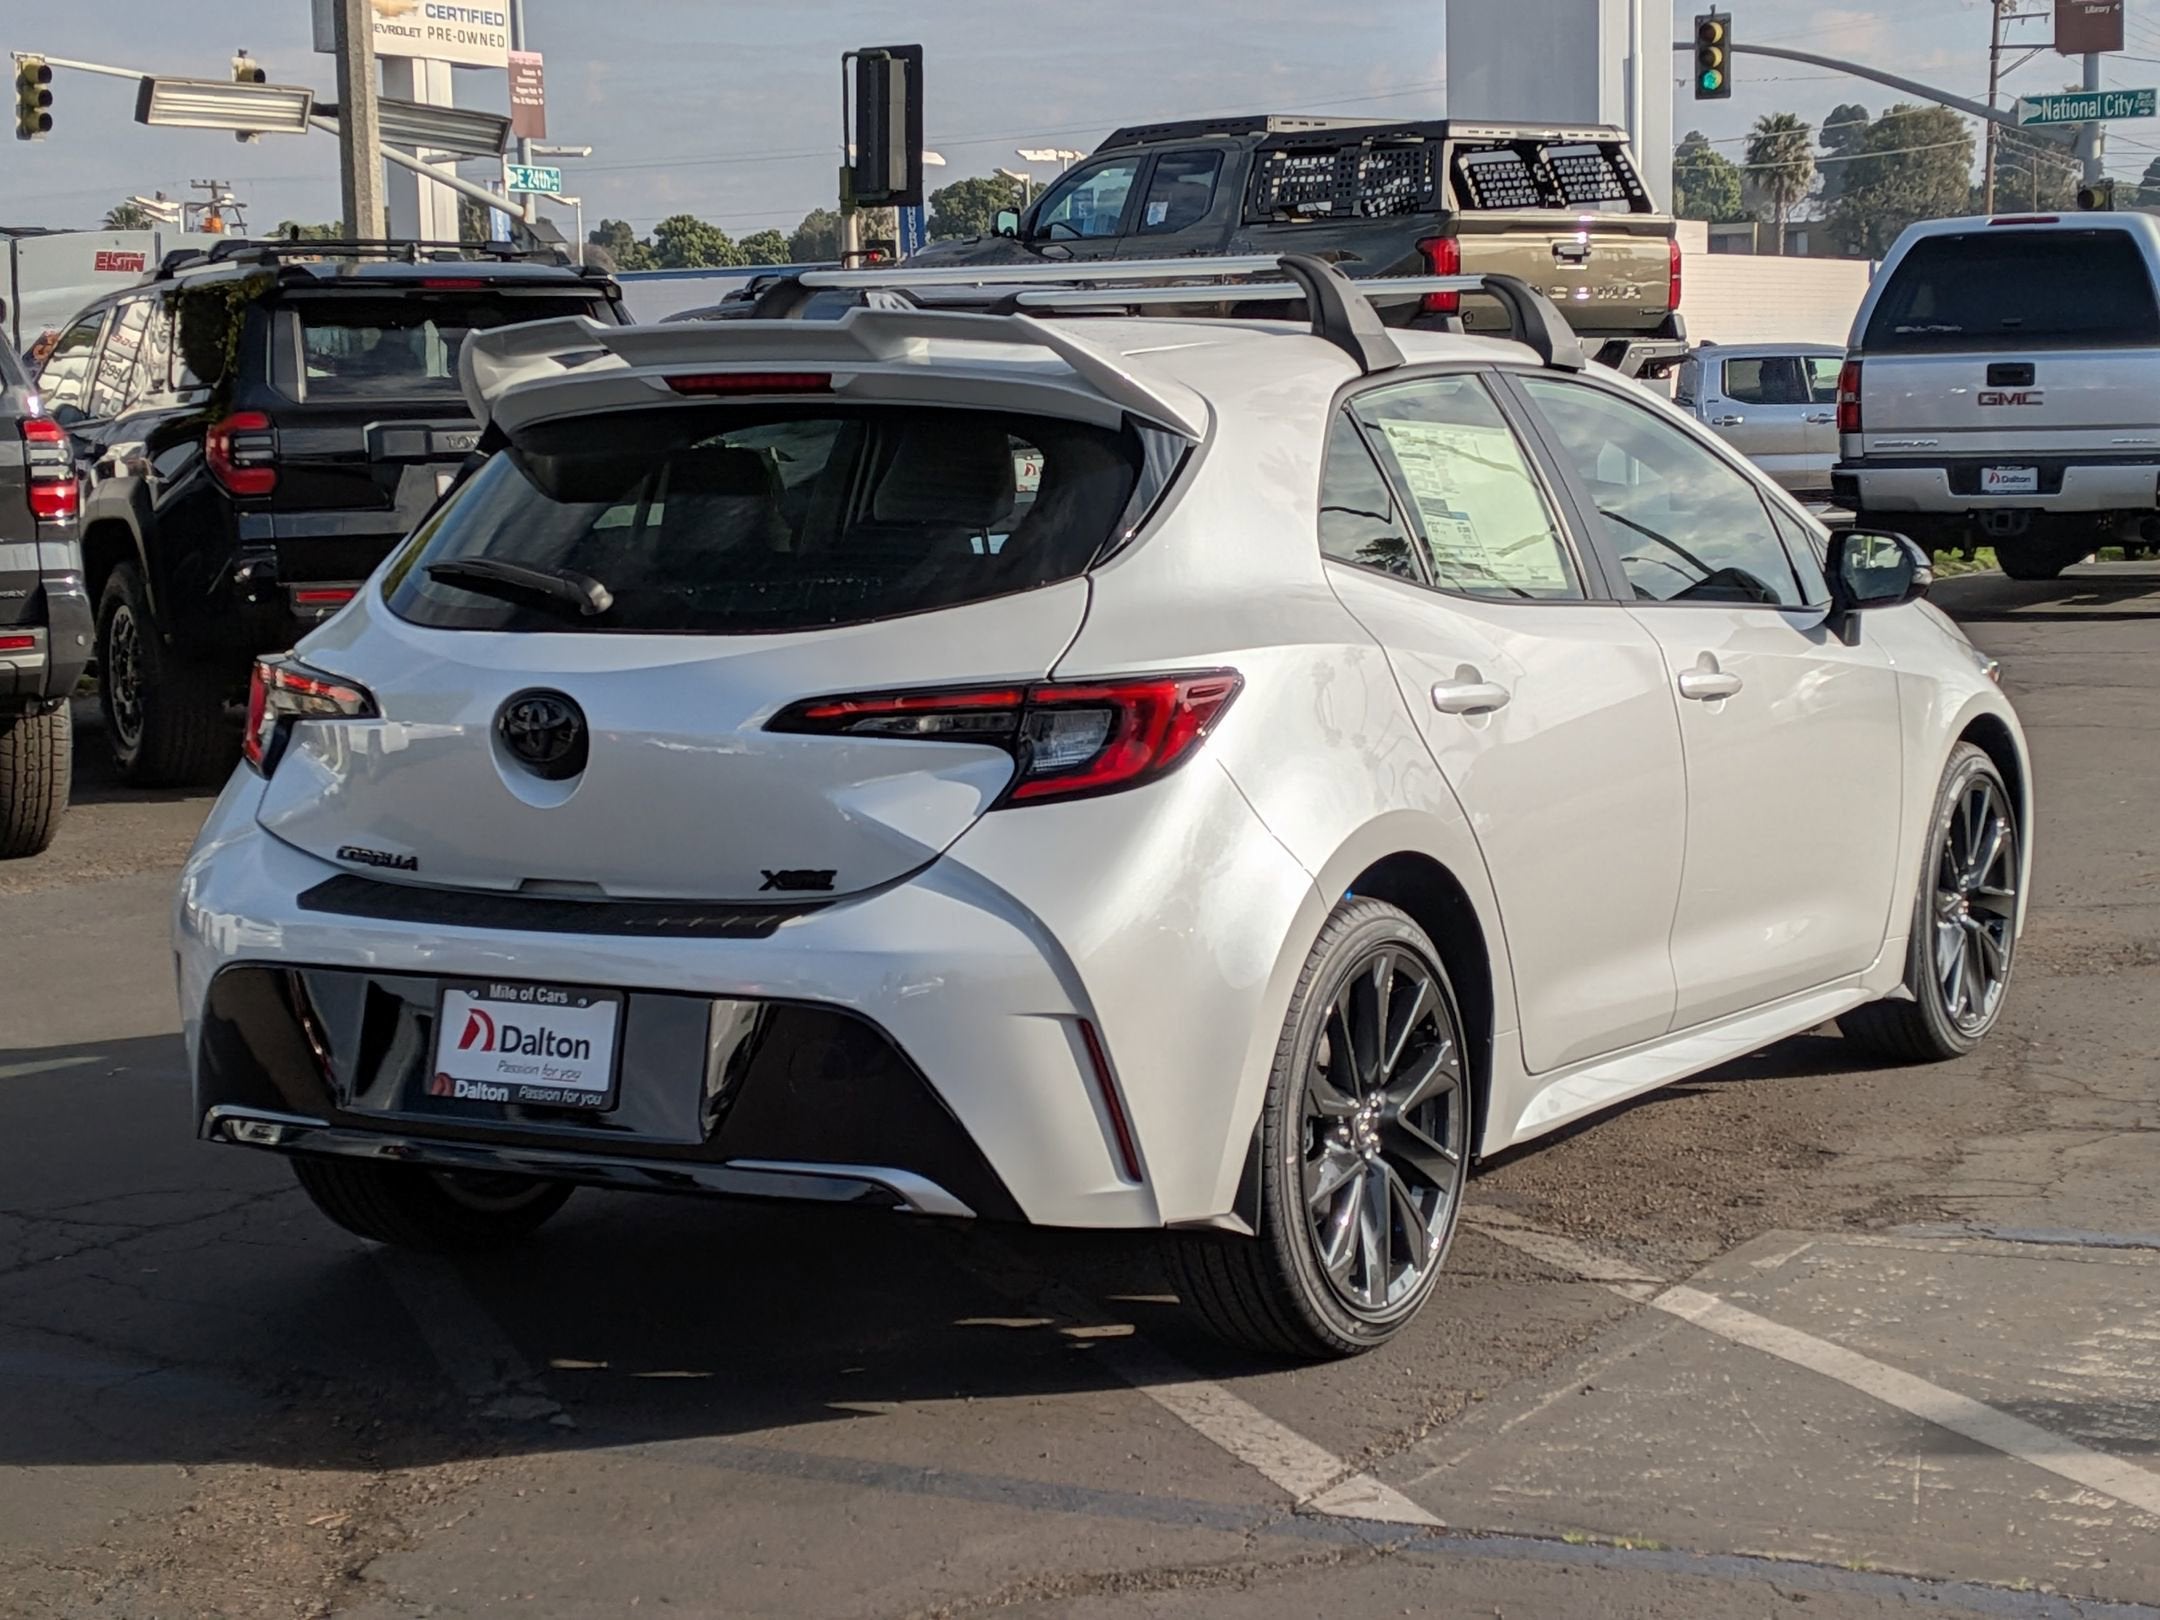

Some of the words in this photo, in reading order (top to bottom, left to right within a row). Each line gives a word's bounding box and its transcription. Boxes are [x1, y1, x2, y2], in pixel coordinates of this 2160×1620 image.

[425, 4, 505, 27] CERTIFIED
[373, 23, 422, 38] EVROLET
[427, 25, 505, 48] PRE-OWNED
[2042, 95, 2101, 121] National
[2104, 93, 2135, 117] City
[516, 168, 527, 189] E
[527, 169, 551, 190] 24th
[94, 251, 145, 273] ELGIN
[1978, 391, 2044, 406] GMC
[489, 984, 517, 1001] Mile
[519, 986, 535, 1001] of
[536, 988, 568, 1004] Cars
[499, 1025, 591, 1061] Dalton
[496, 1060, 540, 1076] Passion
[542, 1063, 558, 1078] for
[559, 1068, 582, 1081] you
[454, 1080, 509, 1102] Dalton
[518, 1086, 561, 1102] Passion
[561, 1089, 580, 1104] for
[578, 1093, 602, 1107] you
